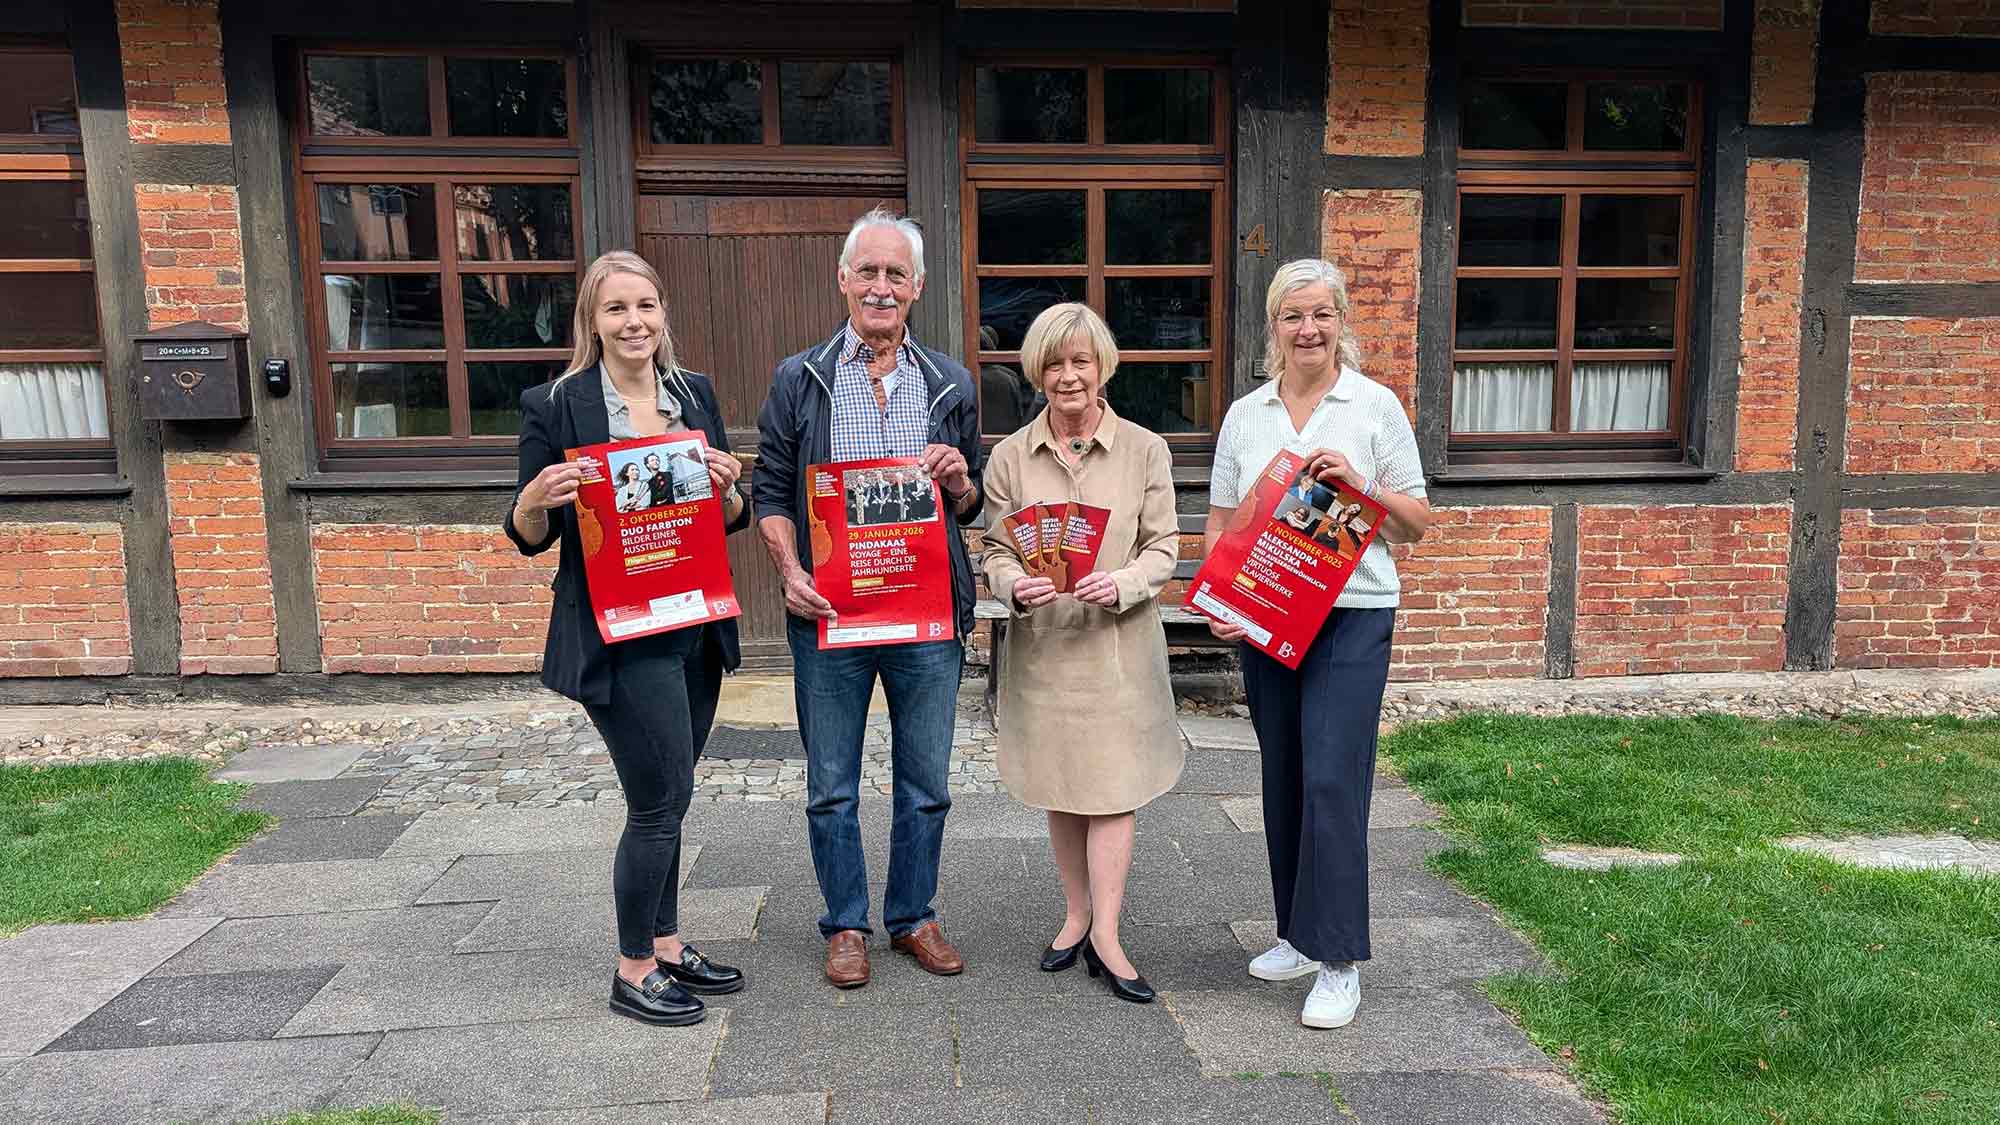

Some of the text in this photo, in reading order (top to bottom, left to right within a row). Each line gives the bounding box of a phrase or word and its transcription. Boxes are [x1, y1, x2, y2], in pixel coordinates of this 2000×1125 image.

[1245, 224, 1270, 256] 4
[619, 505, 699, 527] 2. OKTOBER 2025
[621, 517, 693, 537] DUO FARBTON
[848, 526, 925, 540] 29. JANUAR 2026
[622, 529, 677, 546] BILDER EINER
[624, 537, 682, 555] AUSSTELLUNG
[849, 538, 906, 550] PINDAKAAS
[1266, 520, 1344, 569] 7. NOVEMBER 2025
[849, 549, 881, 559] VOYAGE
[890, 547, 909, 556] EINE
[1256, 538, 1301, 568] MIKULSKA
[1261, 530, 1318, 568] ALEKSANDRA
[851, 555, 918, 568] REISE DURCH DIE
[1246, 557, 1281, 582] VIRTUOSE
[1250, 551, 1274, 568] TALENTE
[1253, 545, 1328, 592] UND AUSSERGEWÖHNLICHE
[851, 564, 913, 577] JAHRHUNDERTE
[1241, 564, 1295, 599] KLAVIERWERKE
